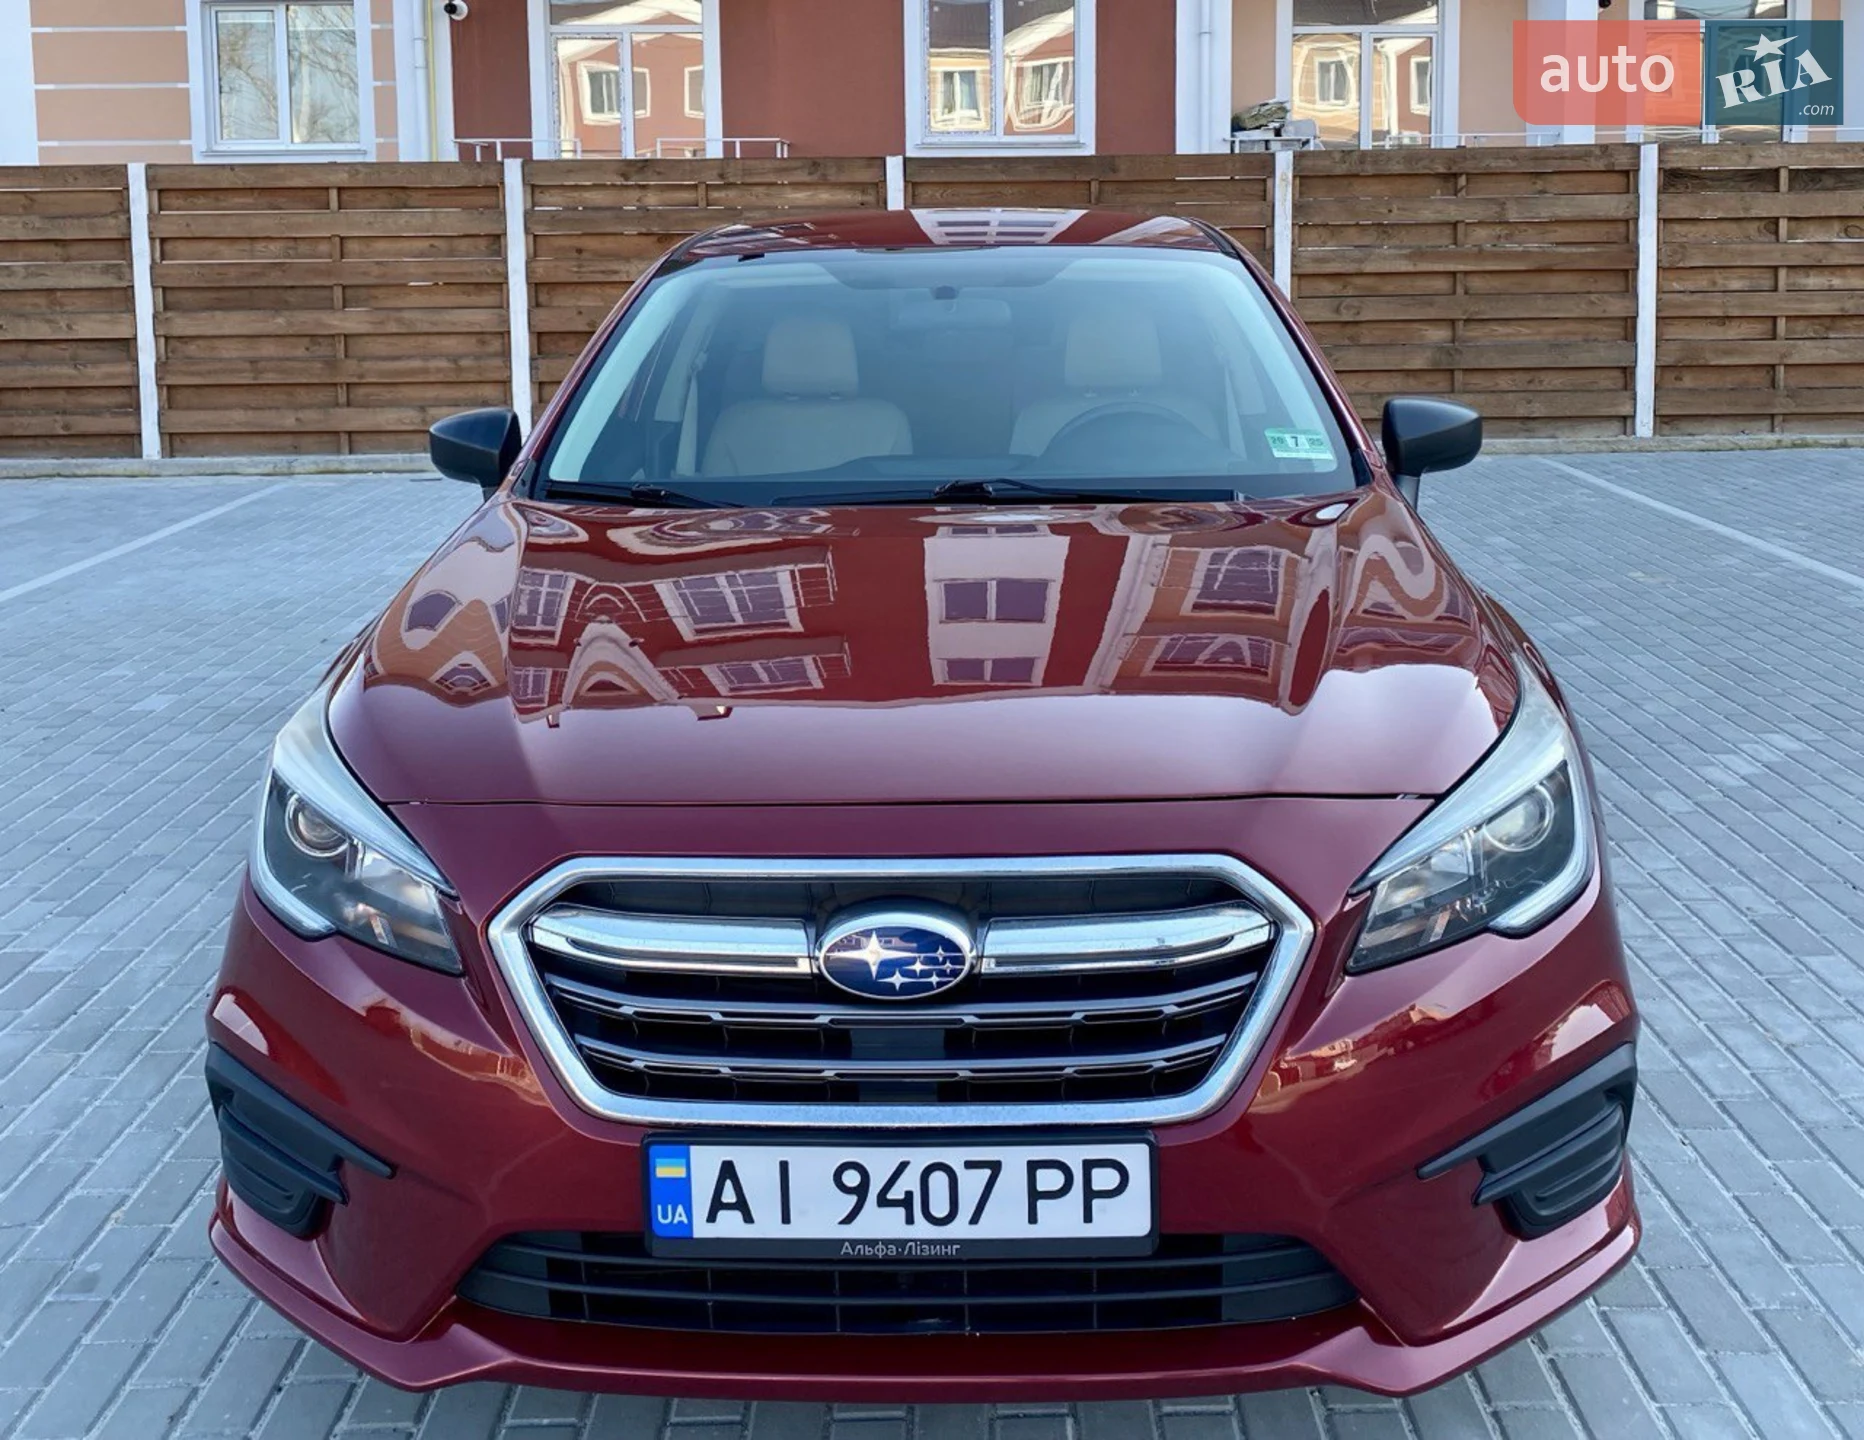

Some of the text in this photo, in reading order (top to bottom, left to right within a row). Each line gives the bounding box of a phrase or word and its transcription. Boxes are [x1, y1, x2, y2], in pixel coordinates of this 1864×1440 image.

[1290, 436, 1299, 447] 7
[705, 1158, 1130, 1227] AI 9407 PP
[657, 1205, 688, 1225] UA
